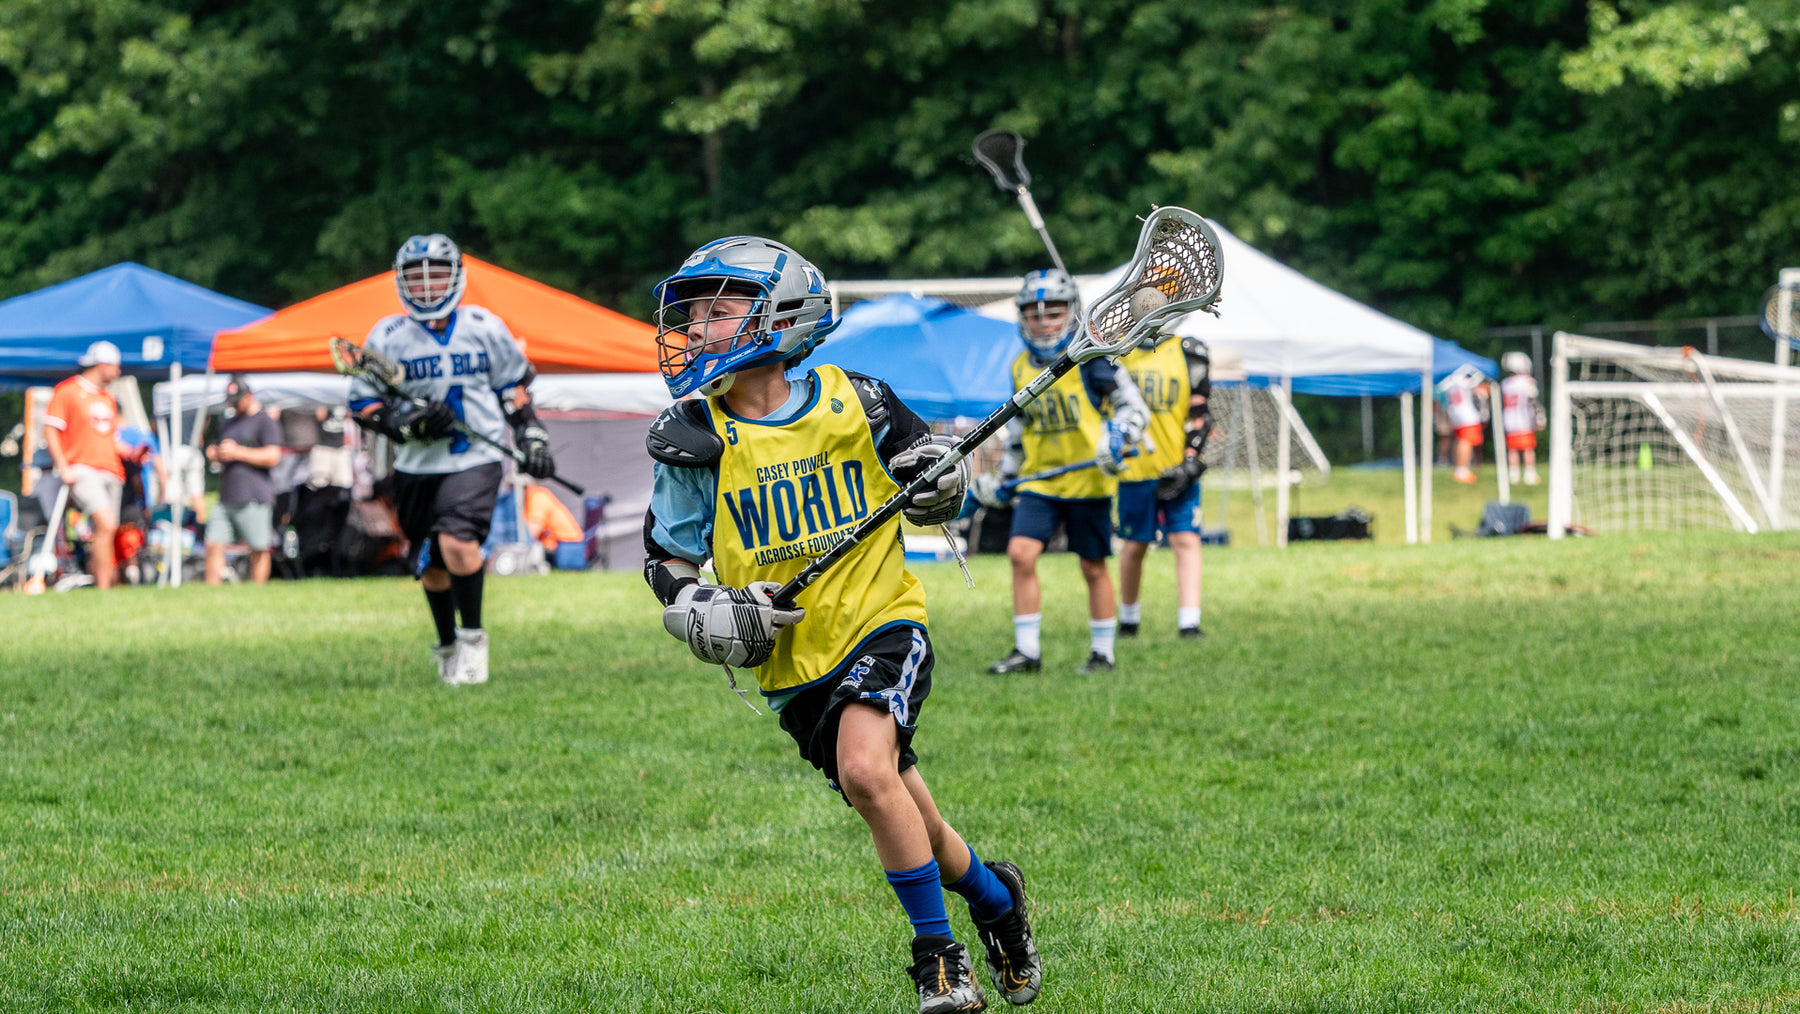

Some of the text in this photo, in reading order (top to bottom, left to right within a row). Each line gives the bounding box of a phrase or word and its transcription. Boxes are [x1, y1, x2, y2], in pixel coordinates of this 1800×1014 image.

[399, 352, 491, 380] RUE BLU
[725, 420, 739, 446] 5
[756, 450, 831, 484] CASEY POWELL
[722, 459, 869, 551] WORLD
[754, 526, 856, 567] LACROSSE FOUNDAT
